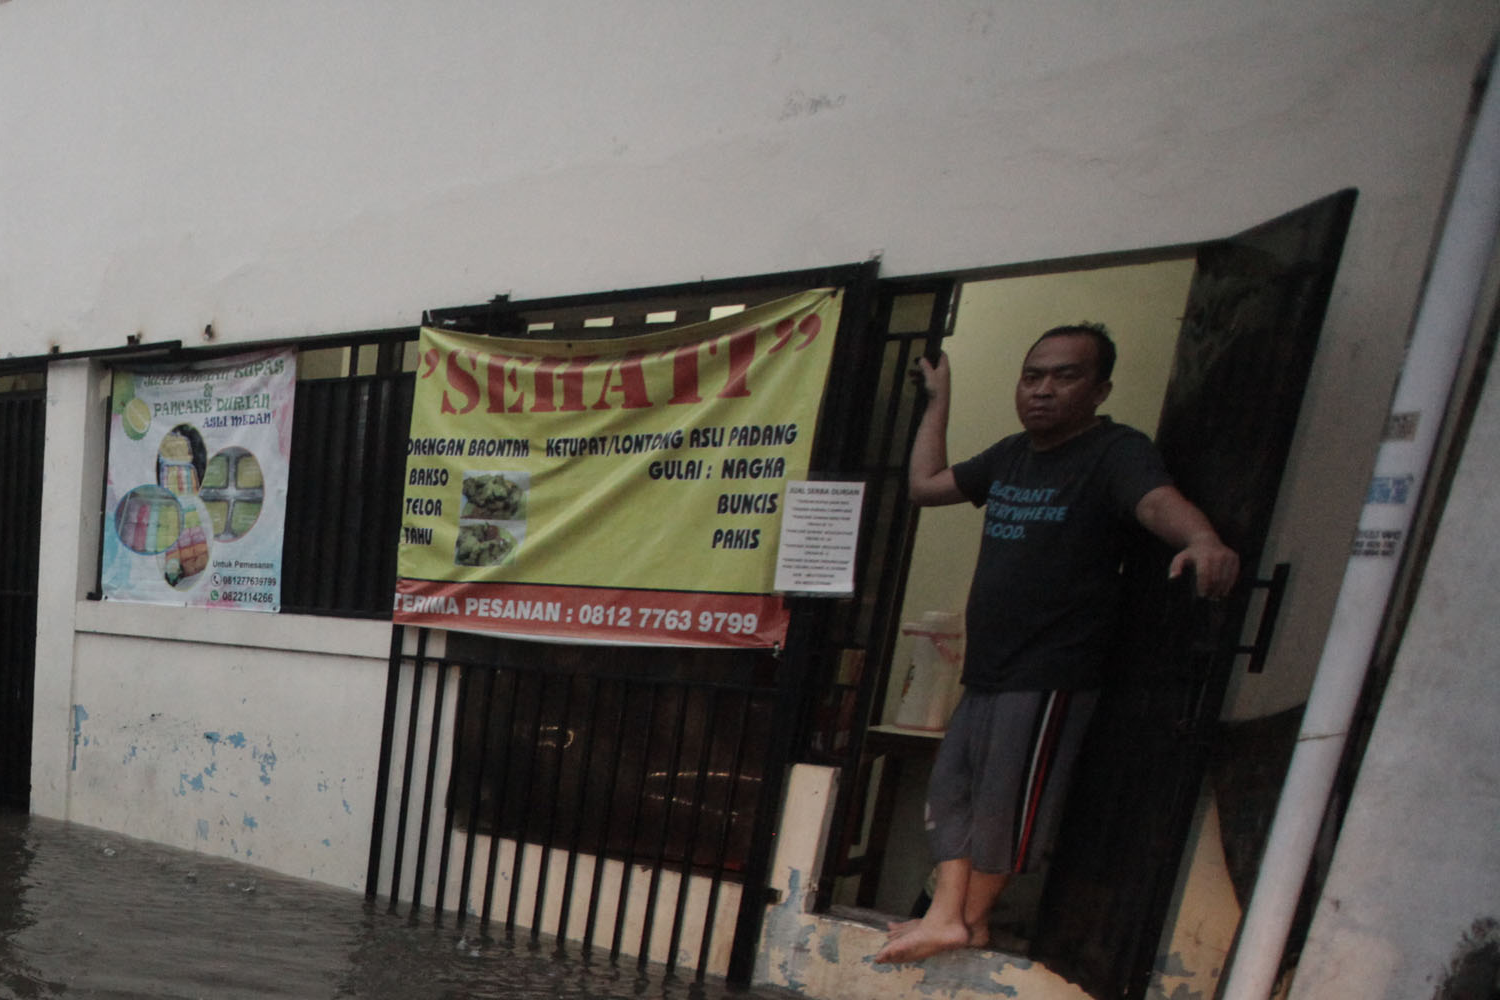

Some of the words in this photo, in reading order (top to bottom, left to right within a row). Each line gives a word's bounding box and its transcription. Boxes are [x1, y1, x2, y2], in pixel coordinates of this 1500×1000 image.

[203, 383, 214, 398] &
[153, 398, 213, 418] PANCAKE
[217, 393, 271, 413] DURIAN
[202, 415, 228, 429] ASLI
[231, 411, 272, 427] MEDAN
[689, 426, 726, 449] ASLI
[729, 423, 798, 447] PADANG
[409, 468, 449, 487] BAKSO
[648, 459, 701, 481] GULAI
[721, 457, 786, 480] NAGKA
[405, 498, 442, 517] TELOR
[717, 493, 779, 515] BUNCIS
[403, 527, 433, 546] TAHU
[712, 528, 761, 550] PAKIS
[212, 560, 232, 568] Untuk
[234, 560, 274, 569] Pemesanan
[464, 599, 561, 623] PESANAN
[578, 604, 631, 627] 0812
[637, 608, 692, 632] 7763
[697, 611, 759, 636] 9799
